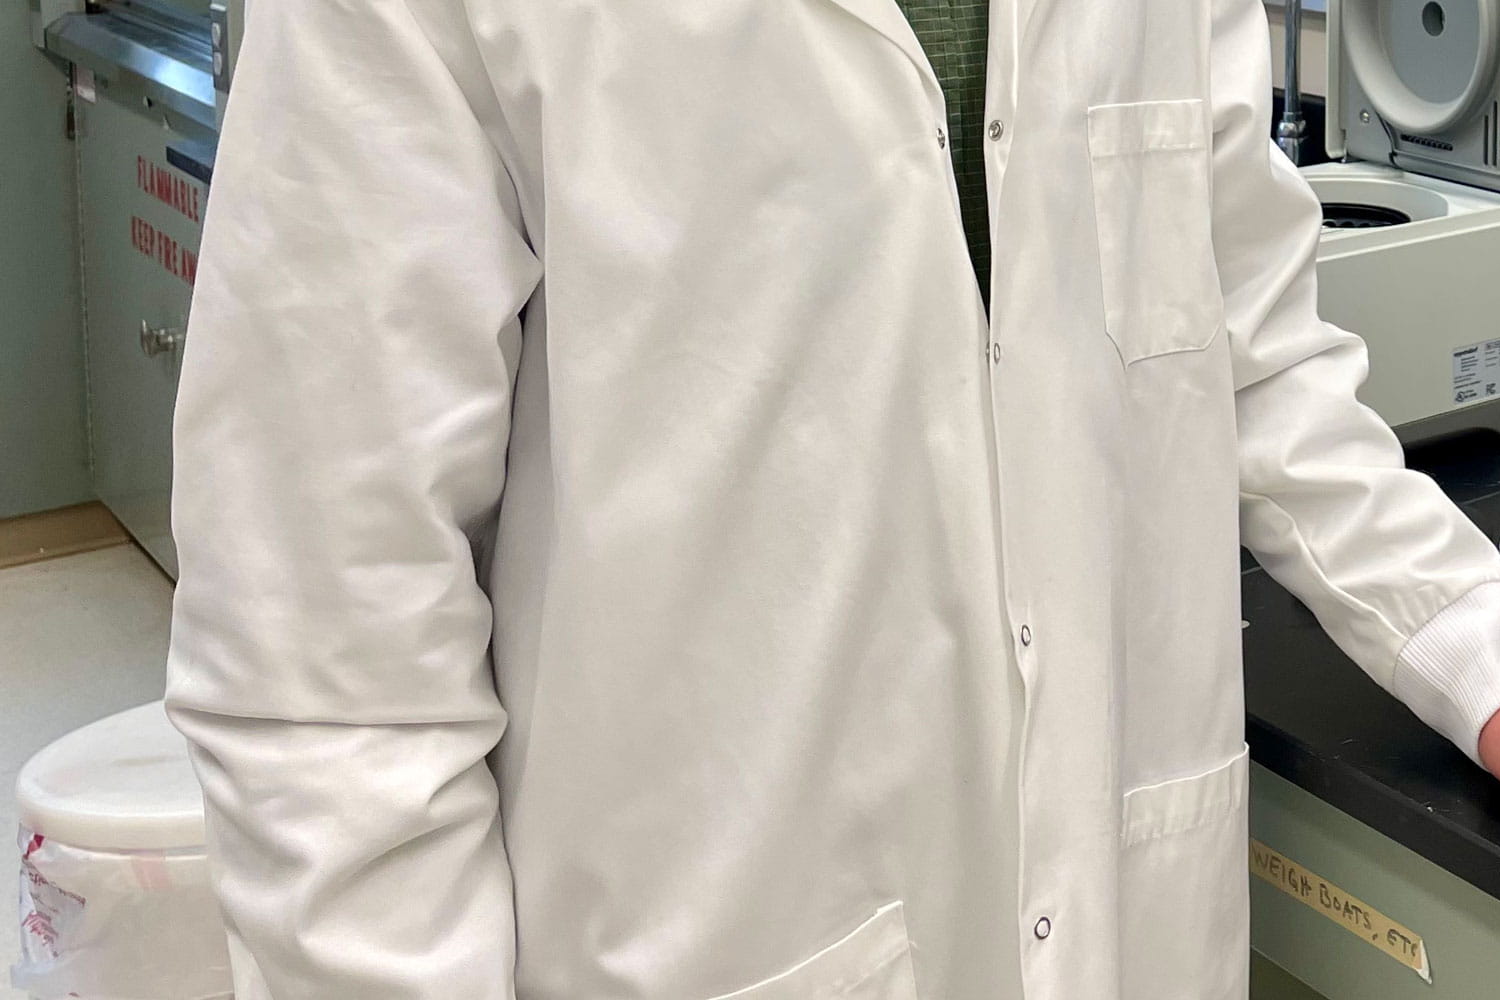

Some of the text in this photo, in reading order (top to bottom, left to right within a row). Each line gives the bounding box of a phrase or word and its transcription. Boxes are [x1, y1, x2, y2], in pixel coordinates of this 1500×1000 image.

[137, 154, 200, 224] FLAMMABLE
[158, 230, 178, 276] FIRE
[1253, 850, 1313, 898] WEIGH
